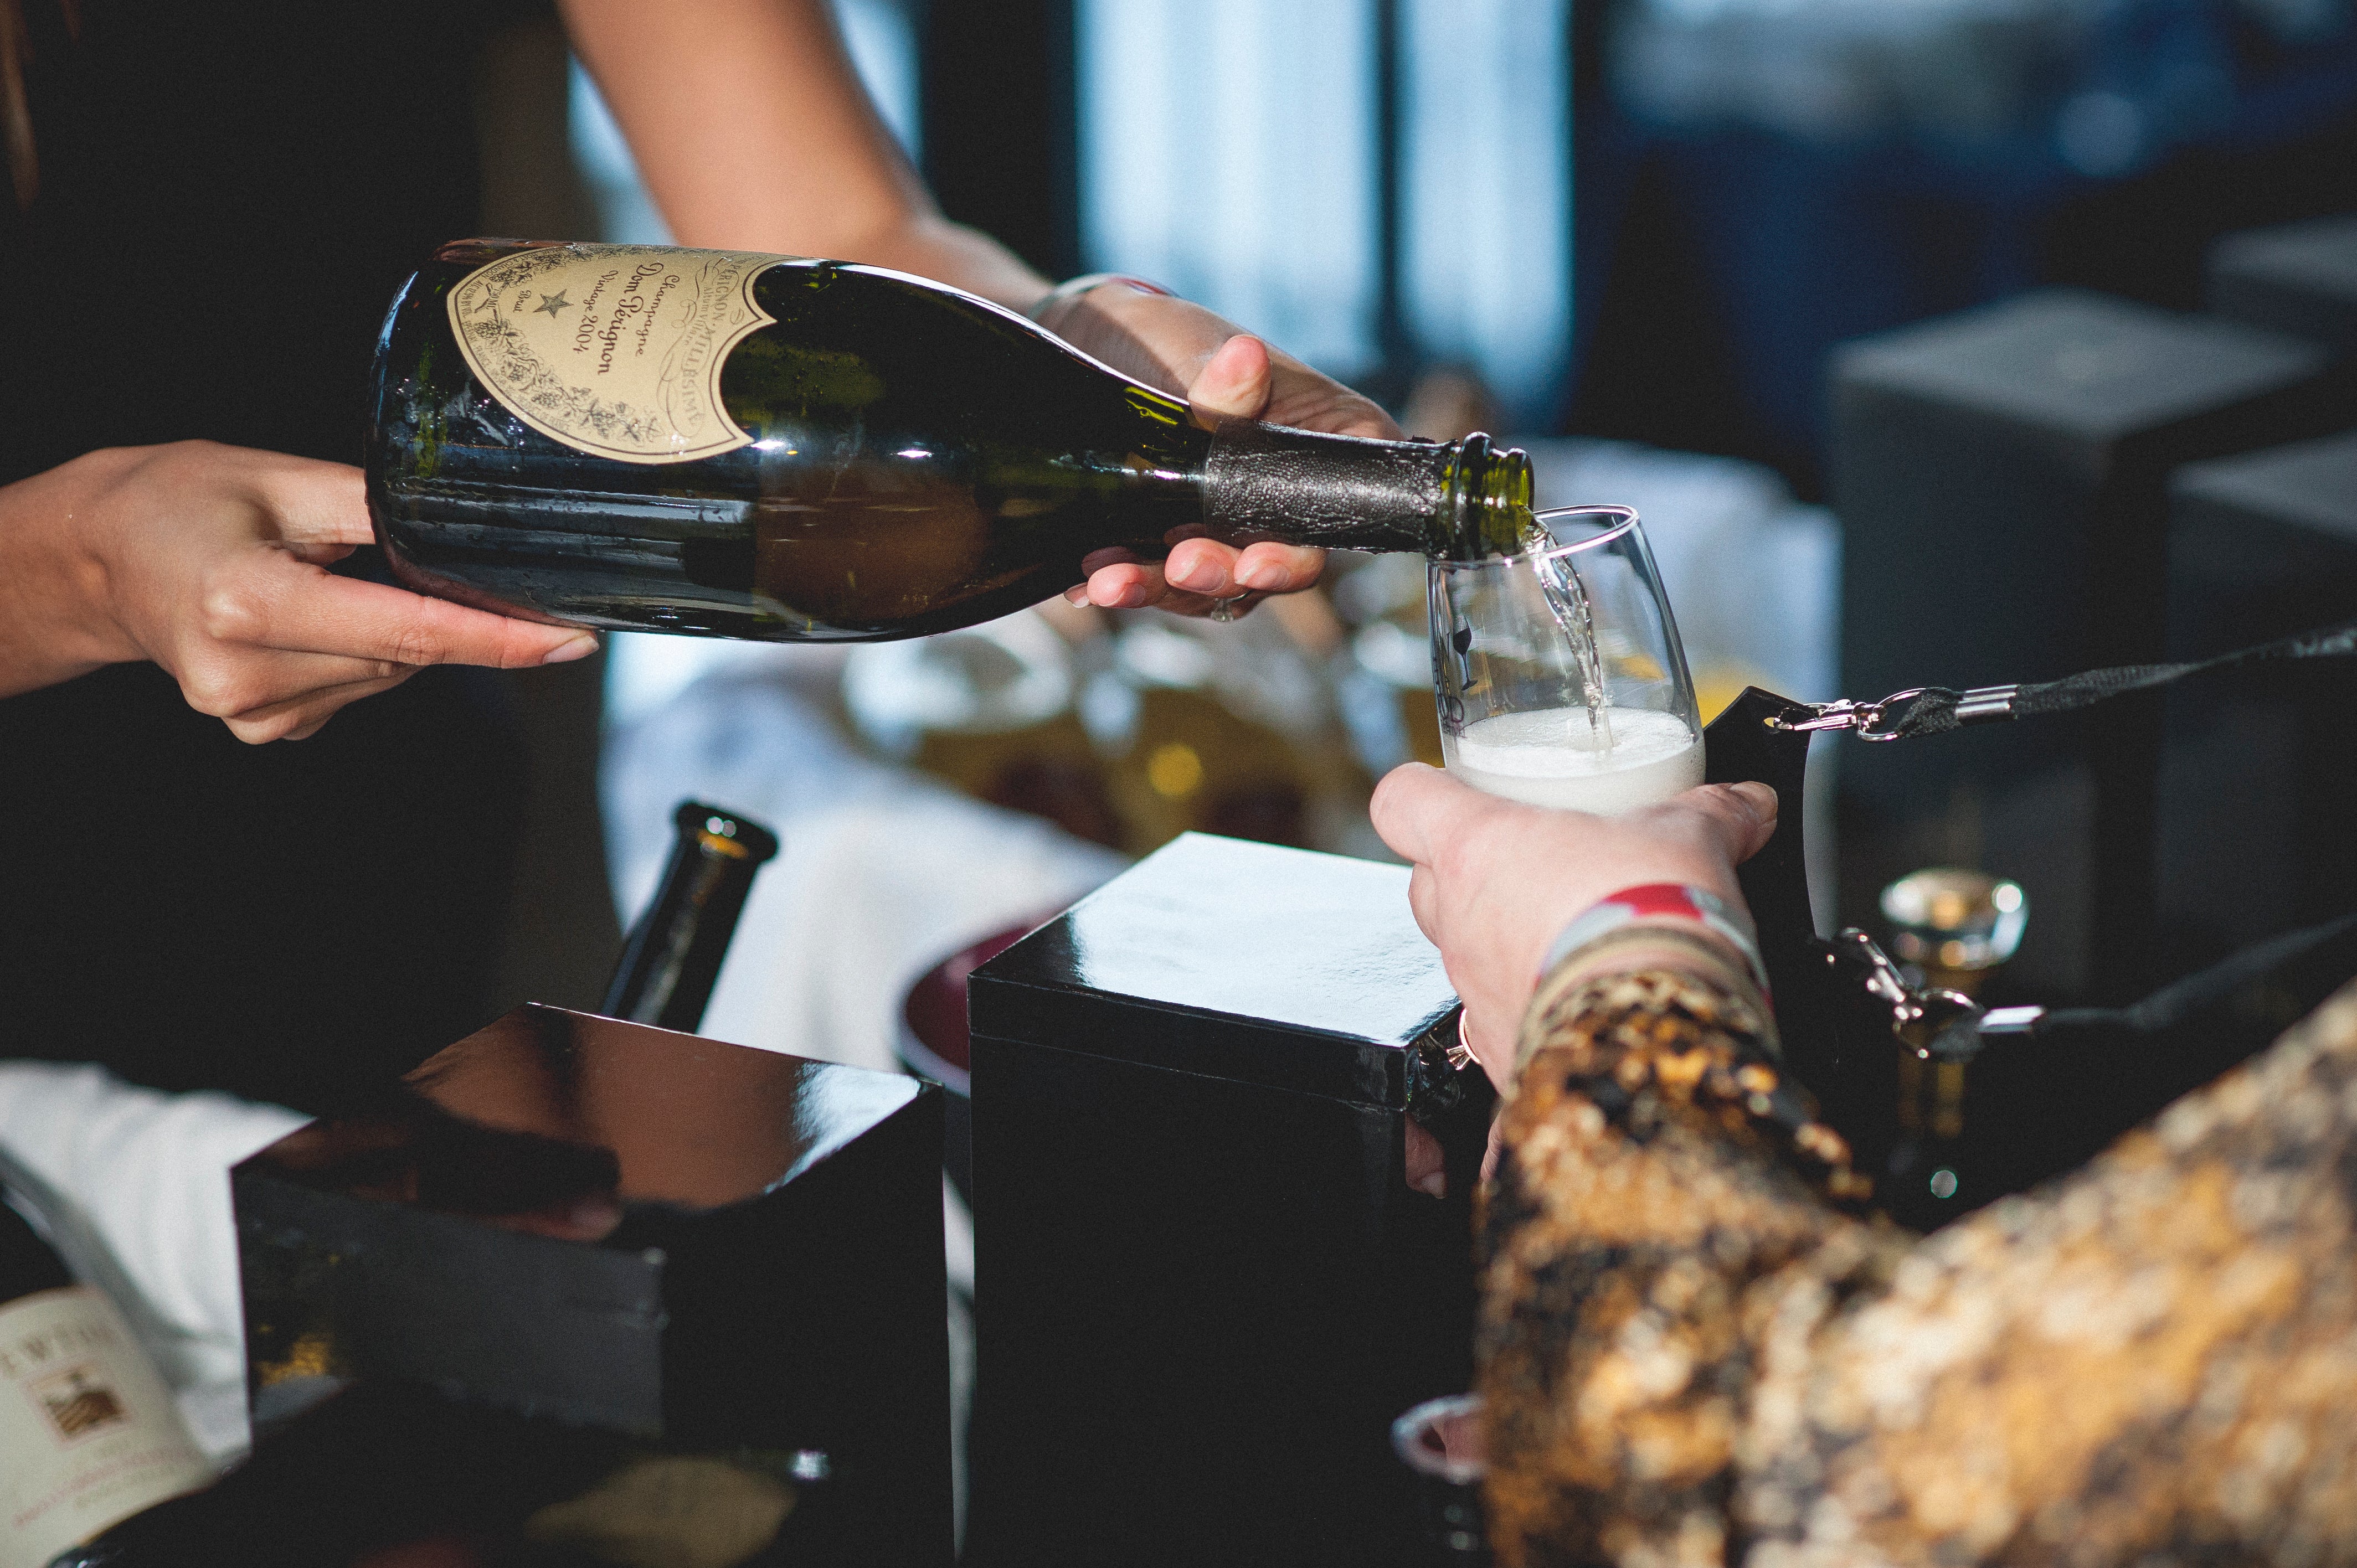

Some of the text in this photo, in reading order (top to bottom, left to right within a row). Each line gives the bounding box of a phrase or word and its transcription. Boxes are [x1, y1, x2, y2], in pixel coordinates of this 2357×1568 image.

[481, 261, 513, 278] CHANDON
[513, 290, 531, 312] Brut
[573, 270, 618, 354] Vintage 2004
[598, 262, 664, 375] Dom Pérignon
[636, 275, 681, 357] Champagne
